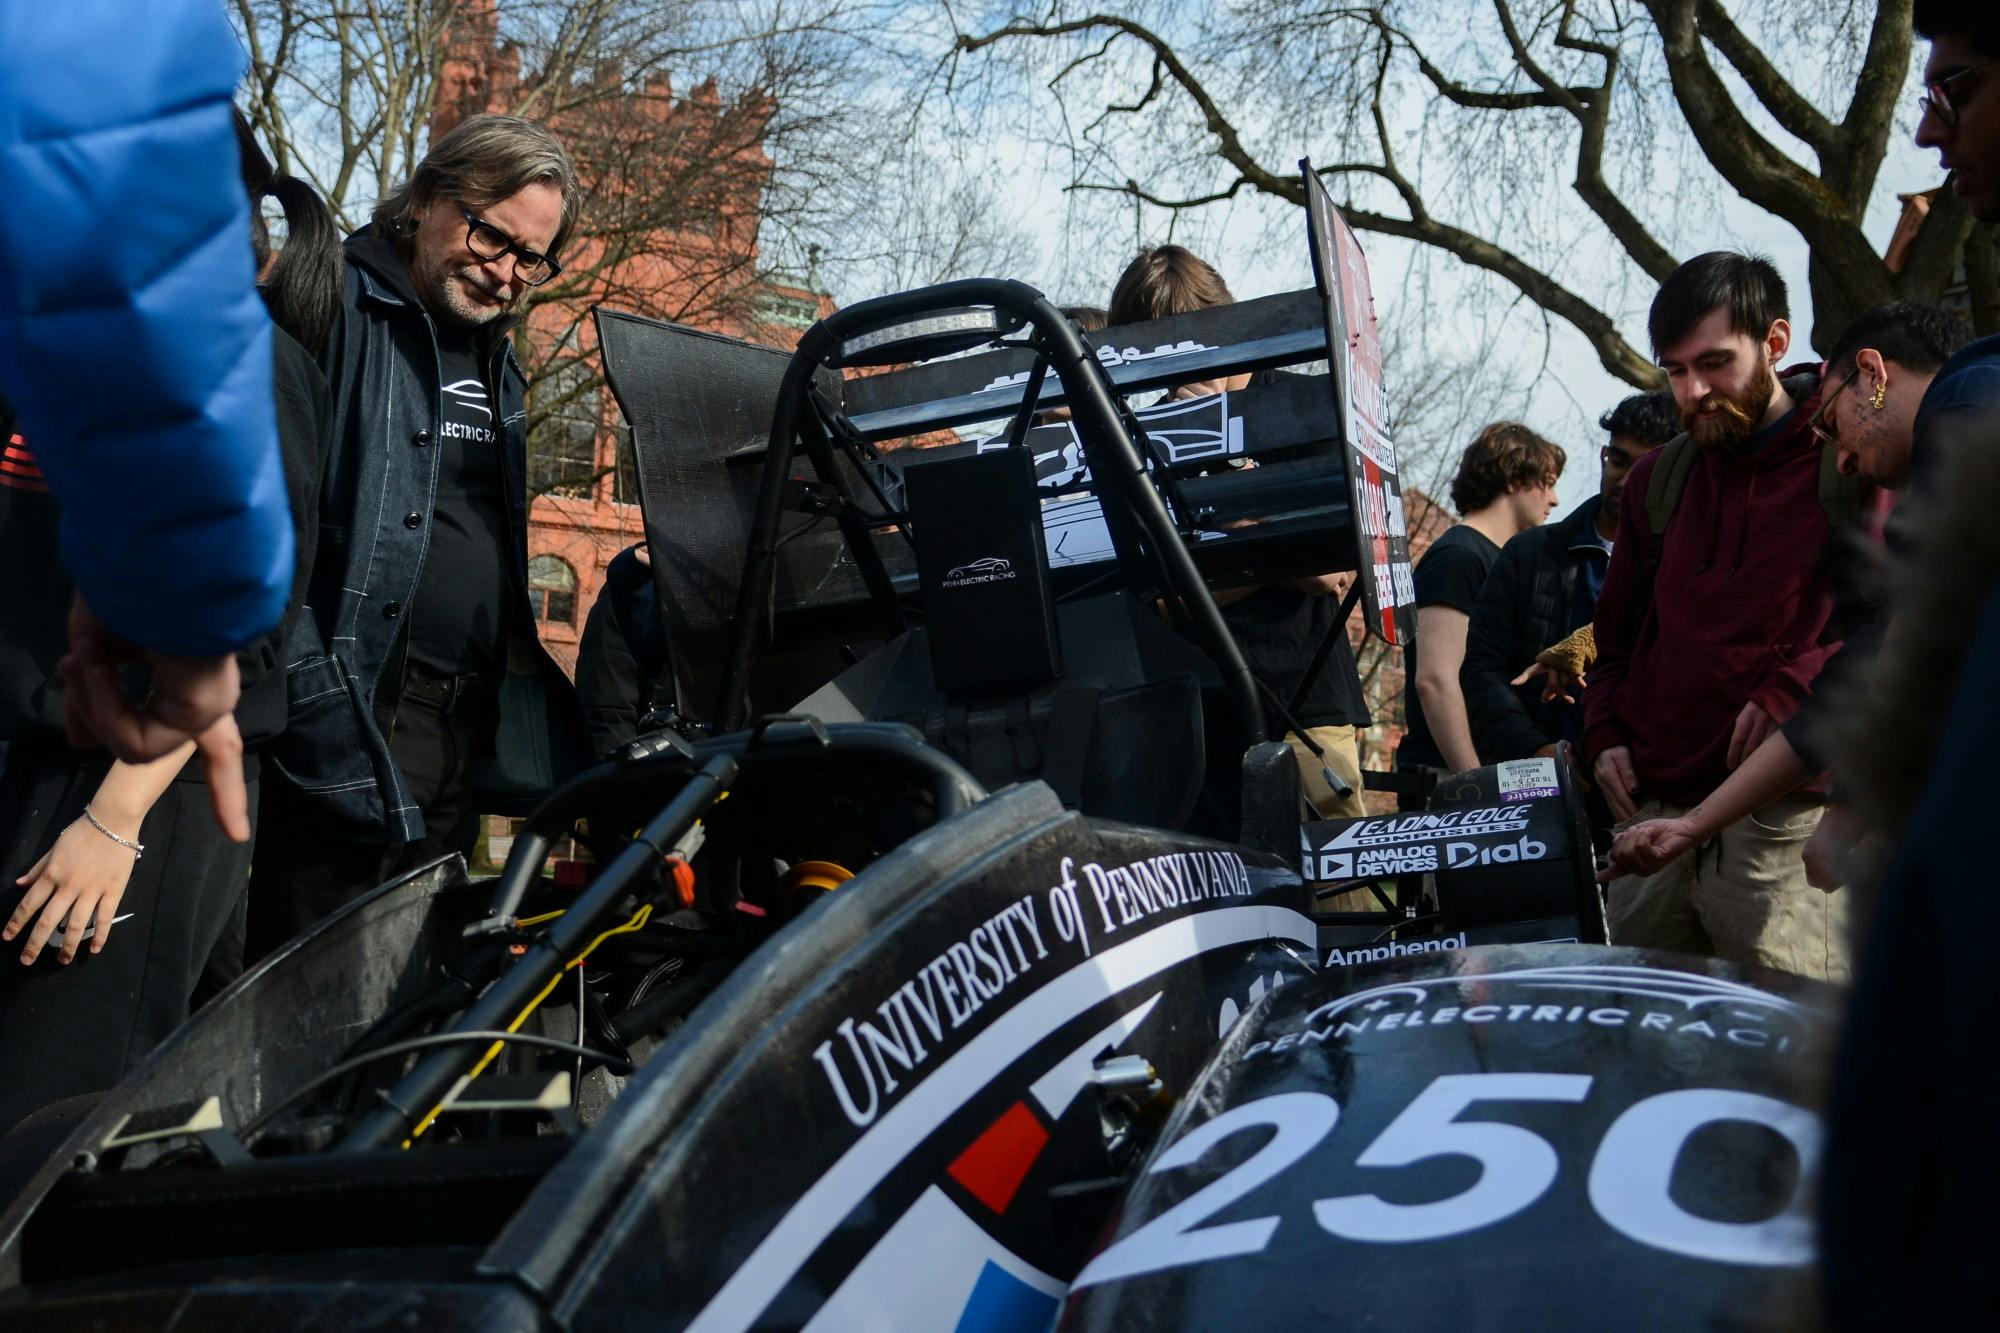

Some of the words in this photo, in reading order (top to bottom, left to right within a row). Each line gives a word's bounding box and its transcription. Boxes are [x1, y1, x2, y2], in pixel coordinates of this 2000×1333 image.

[1340, 811, 1461, 842] LEADING
[1459, 804, 1533, 825] EDGE
[1357, 821, 1523, 846] COMPOSITES
[1357, 845, 1437, 863] ANALOG
[1357, 857, 1439, 877] DEVICES
[1325, 931, 1466, 968] Amphenol
[813, 895, 1049, 1127] UNIVERSITY
[1049, 856, 1091, 957] of
[1082, 851, 1252, 933] PENNSYLVANIA
[1068, 1072, 1830, 1295] 250
